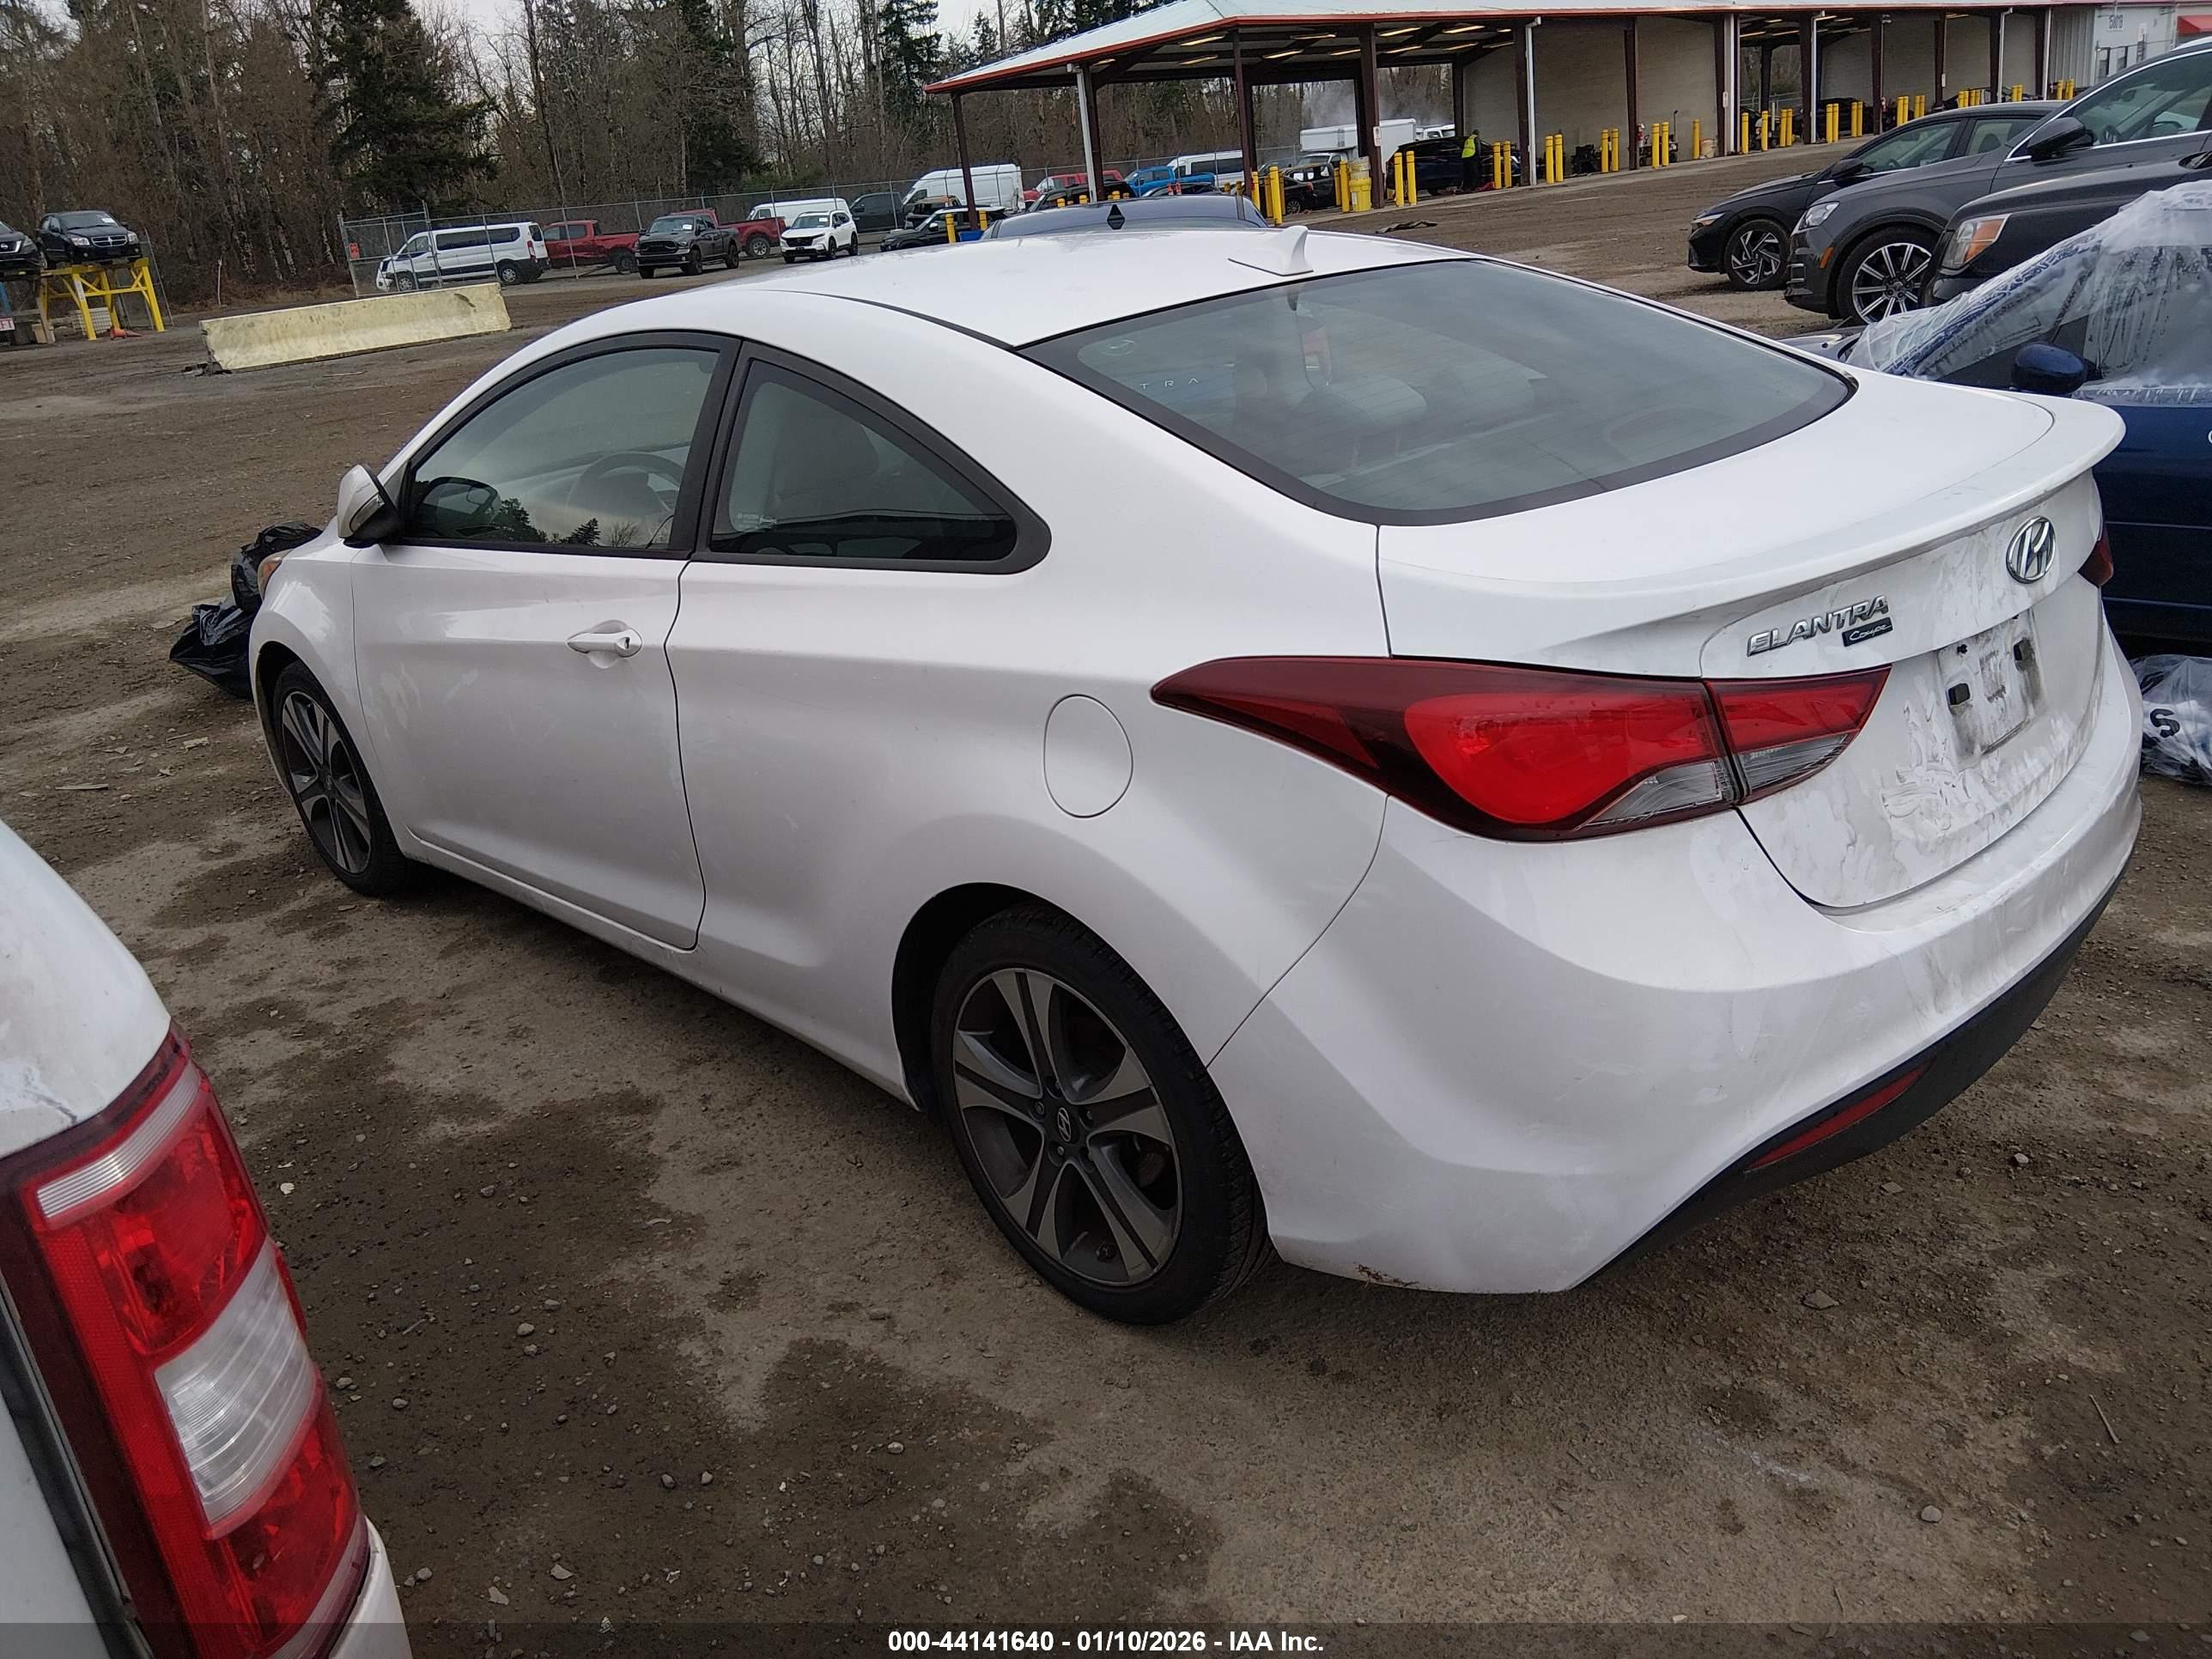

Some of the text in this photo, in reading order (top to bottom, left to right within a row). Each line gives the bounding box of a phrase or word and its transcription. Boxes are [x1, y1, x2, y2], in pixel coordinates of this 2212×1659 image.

[0, 319, 12, 330] FT
[1747, 594, 1889, 658] ELANTRA
[1849, 624, 1893, 642] Coupe
